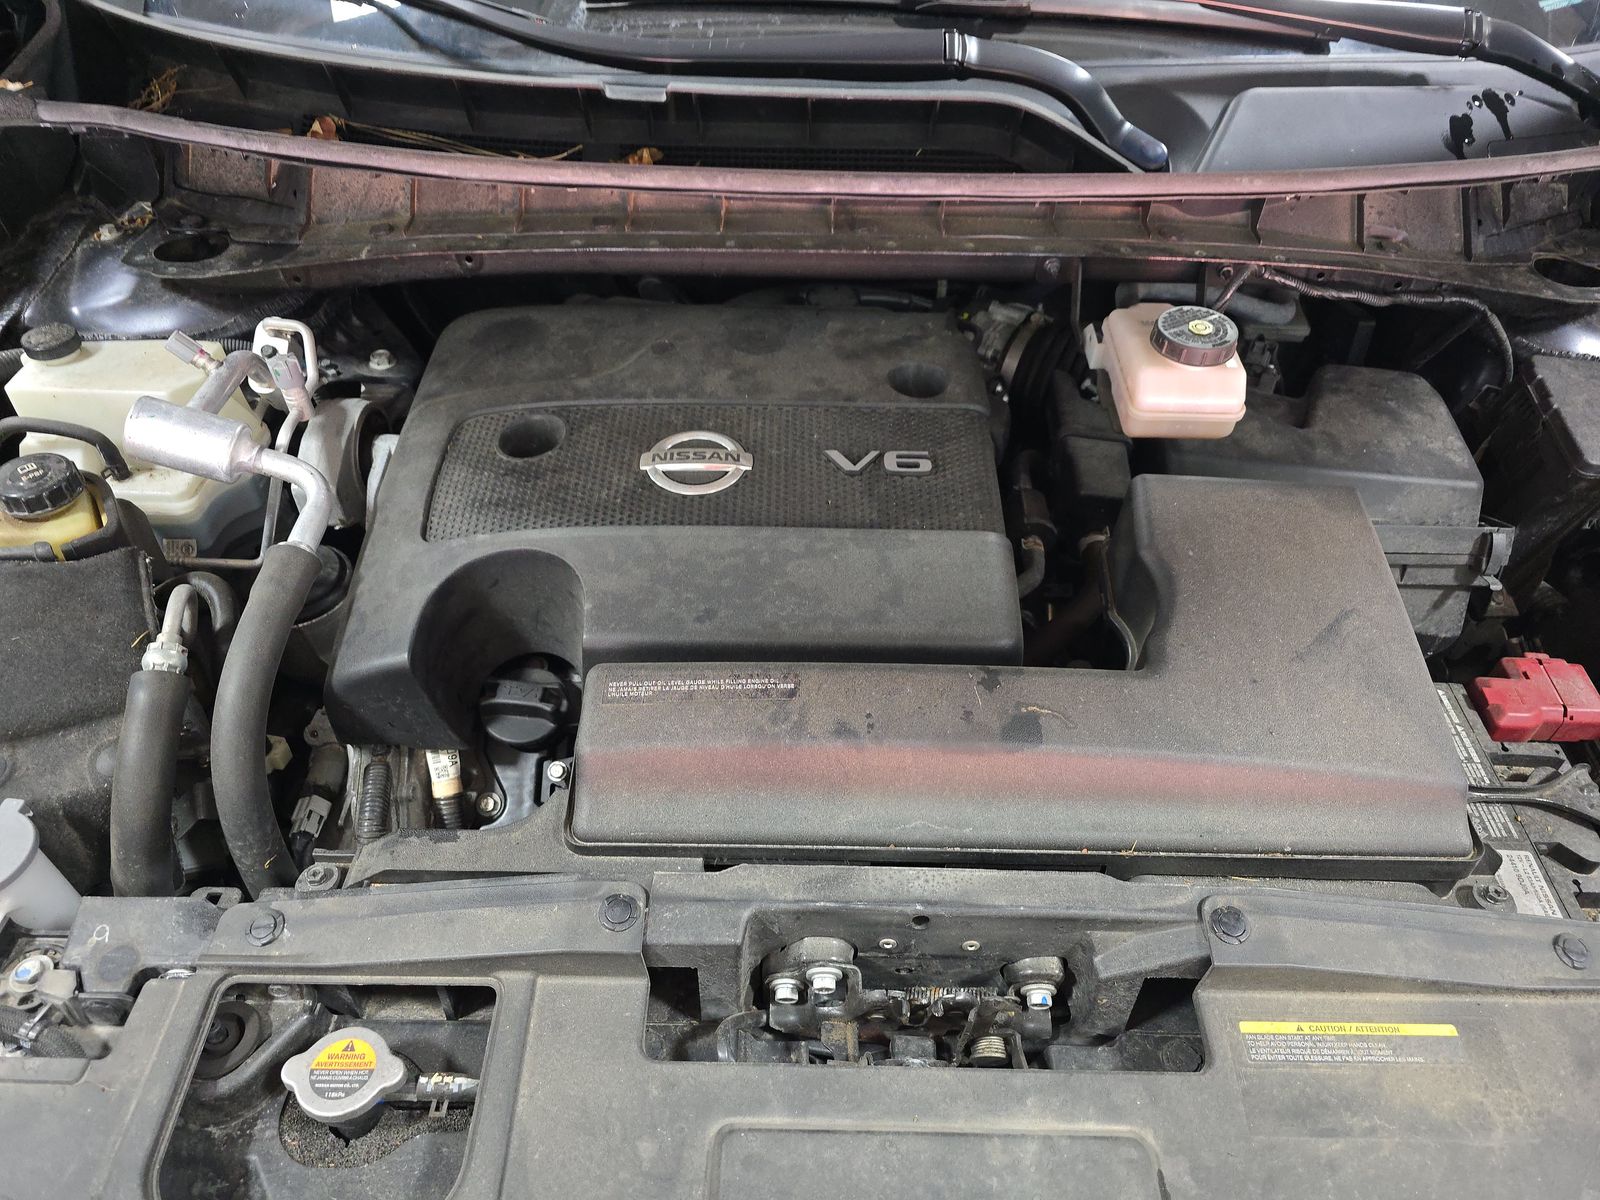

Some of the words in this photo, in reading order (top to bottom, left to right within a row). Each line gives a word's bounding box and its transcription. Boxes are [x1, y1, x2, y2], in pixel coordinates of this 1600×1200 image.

[651, 451, 742, 463] NISSAN
[824, 450, 933, 474] V6
[1539, 885, 1559, 916] NISSAN
[1308, 1025, 1347, 1033] CAUTION
[1355, 1025, 1401, 1034] ATTENTION
